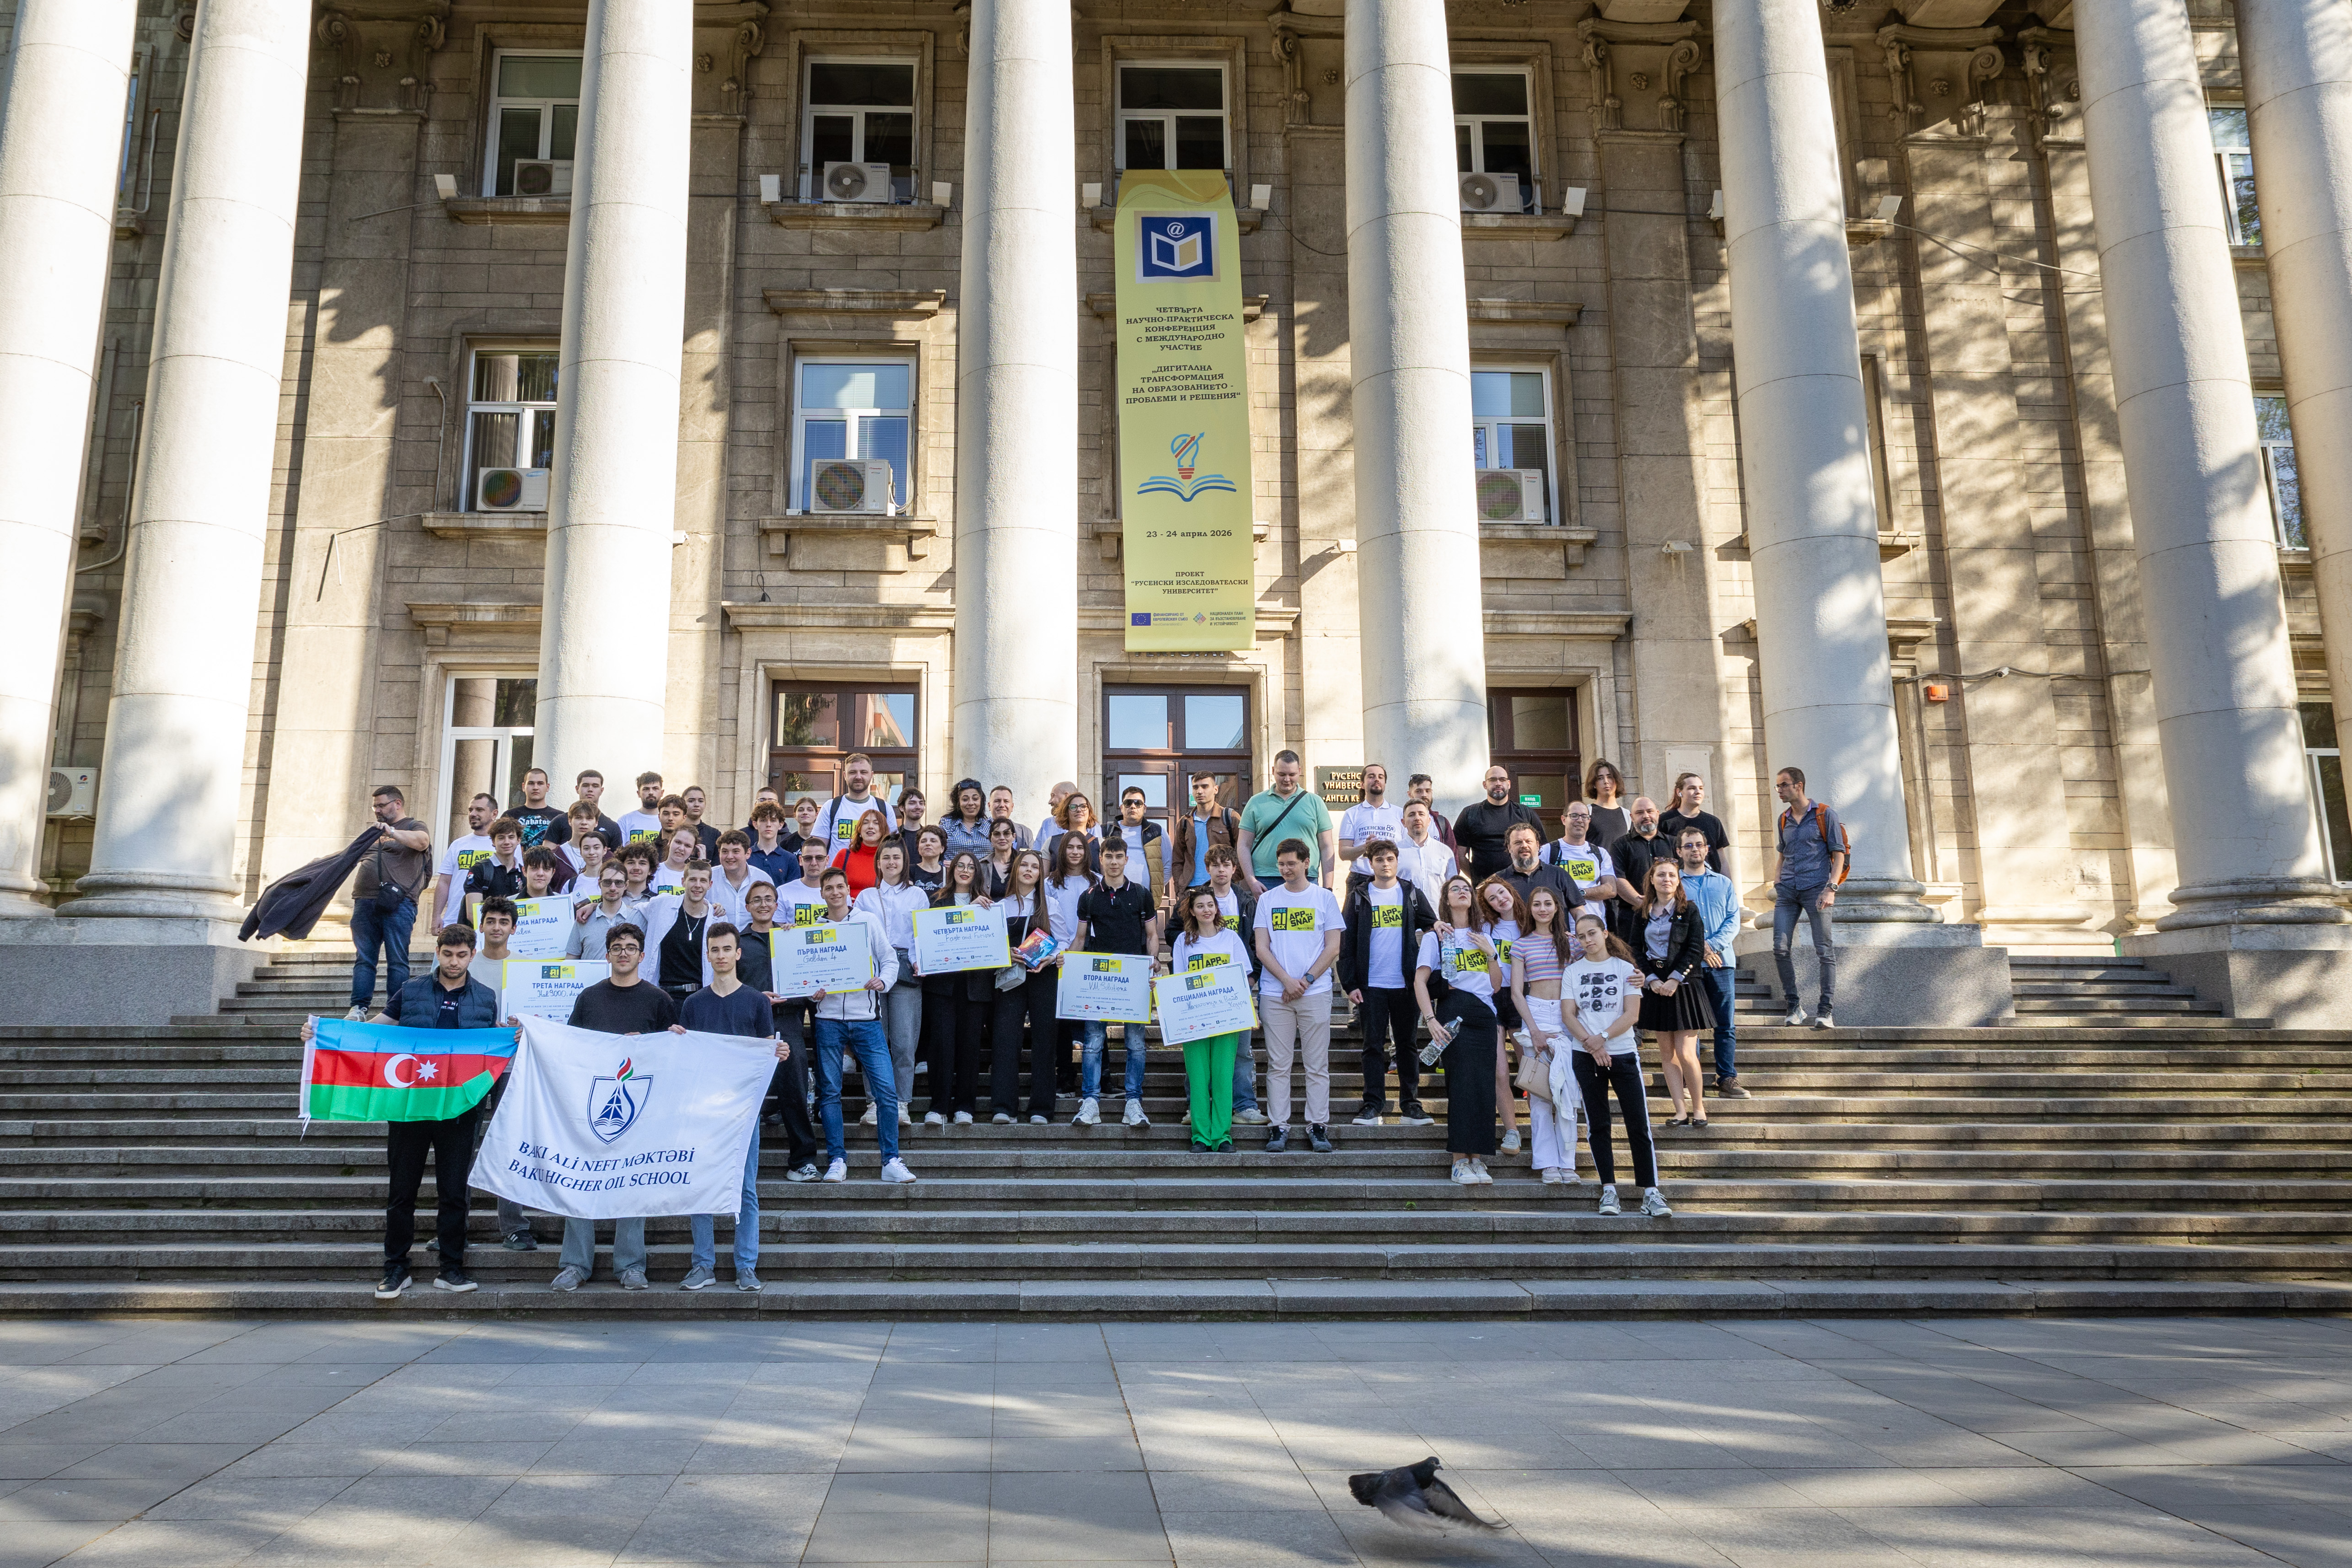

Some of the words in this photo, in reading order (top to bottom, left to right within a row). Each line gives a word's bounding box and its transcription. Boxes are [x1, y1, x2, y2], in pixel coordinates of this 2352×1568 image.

[1126, 314, 1234, 324] НАУЧНО-ПРАКТИЧЕСКА
[1145, 324, 1215, 333] КОНФЕРЕНЦИЯ
[1145, 333, 1224, 342] МЕЖДУНАРОДНО
[1141, 373, 1224, 383] ТРАНСФОРМАЦИЯ
[1148, 383, 1228, 392] ОБРАЗОВАНИЕТО
[1126, 395, 1177, 404] ПРОБЛЕМИ
[838, 824, 851, 834] AI
[458, 854, 472, 865] AI
[474, 853, 489, 861] APP
[1573, 867, 1593, 876] SNAP
[795, 909, 810, 921] AI
[1289, 911, 1305, 920] APP
[1382, 908, 1397, 918] APP
[531, 917, 558, 925] НАГРАДА
[1226, 918, 1235, 927] PP
[1272, 913, 1286, 924] AI
[1290, 916, 1313, 927] SNAP
[933, 927, 962, 935] ЧЕТВЪРТА
[820, 945, 847, 953] НАГРАДА
[1466, 952, 1481, 961] APP
[1206, 956, 1221, 967] APP
[1468, 958, 1487, 967] SNAP
[1172, 992, 1207, 1003] СПЕЦИАЛНА
[1208, 986, 1234, 997] НАГРАДА
[518, 1141, 549, 1159] BAKI
[549, 1153, 580, 1170] ALİ
[580, 1159, 621, 1171] NEFT
[621, 1147, 695, 1169] MƏKTƏBİ
[508, 1159, 544, 1181] BAKU
[545, 1170, 602, 1192] HIGHER
[605, 1176, 626, 1190] OIL
[629, 1171, 691, 1187] SCHOOL
